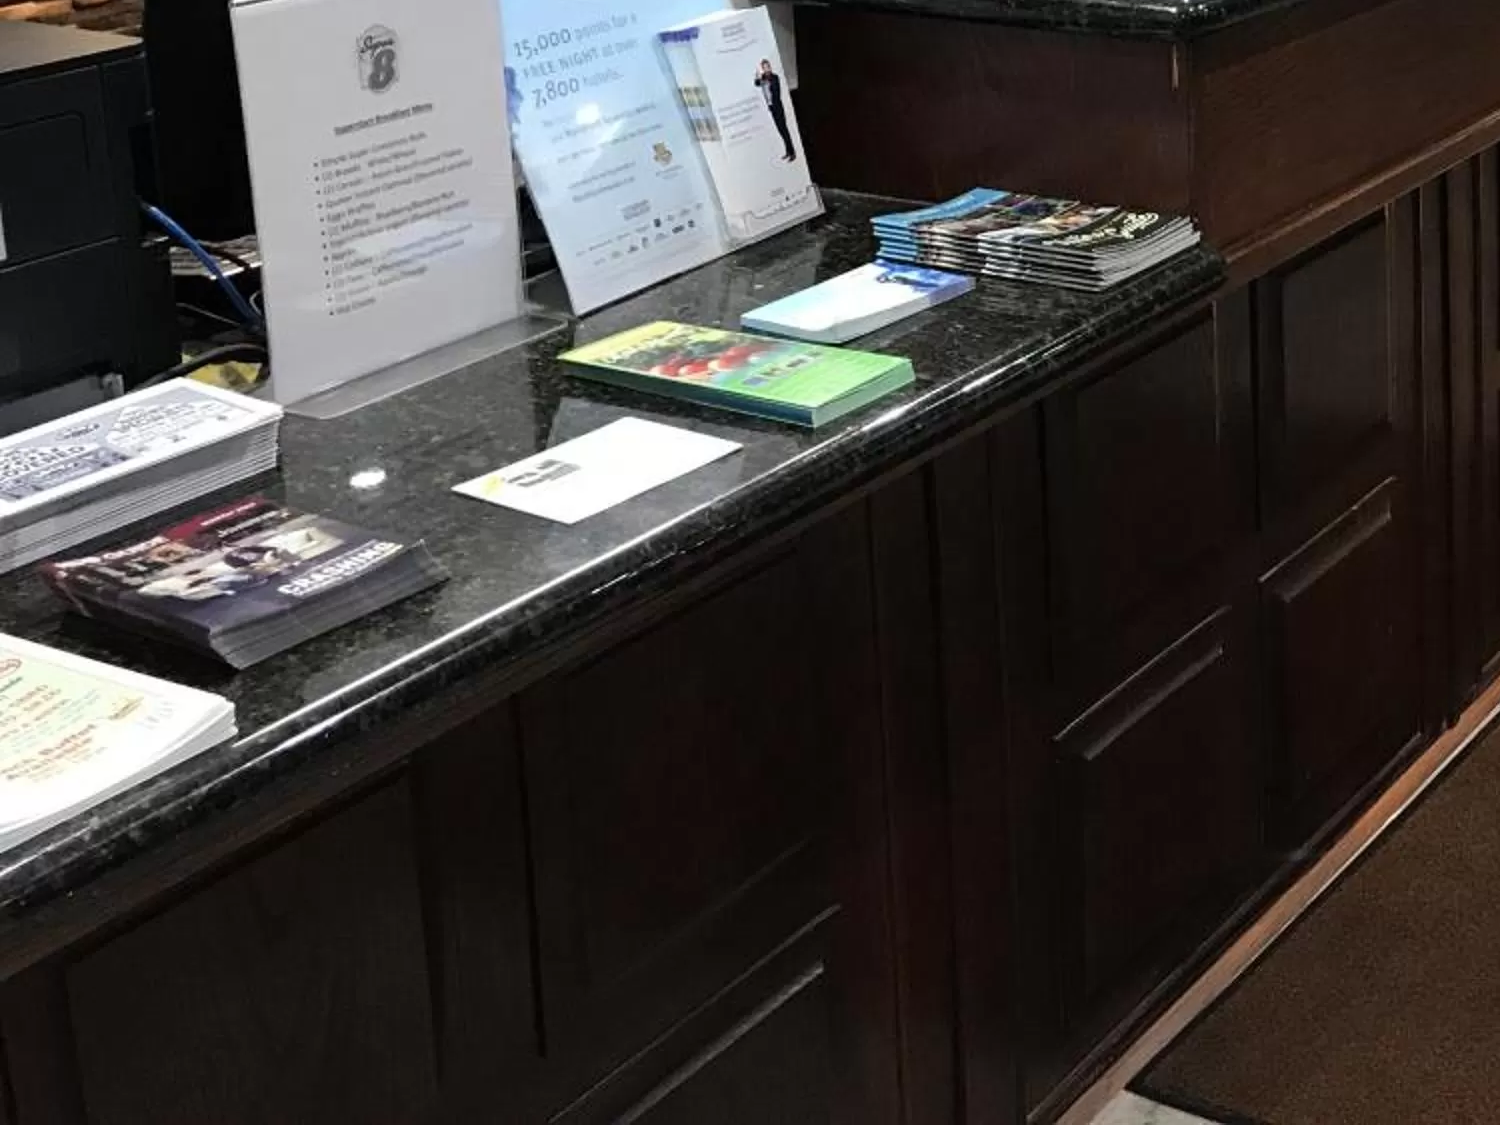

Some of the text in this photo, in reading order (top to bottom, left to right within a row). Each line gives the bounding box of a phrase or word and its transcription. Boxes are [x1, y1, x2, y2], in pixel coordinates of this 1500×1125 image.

[513, 27, 571, 61] 15,000
[559, 46, 598, 70] NIGHT
[368, 48, 396, 91] 8
[531, 77, 579, 109] 7,800
